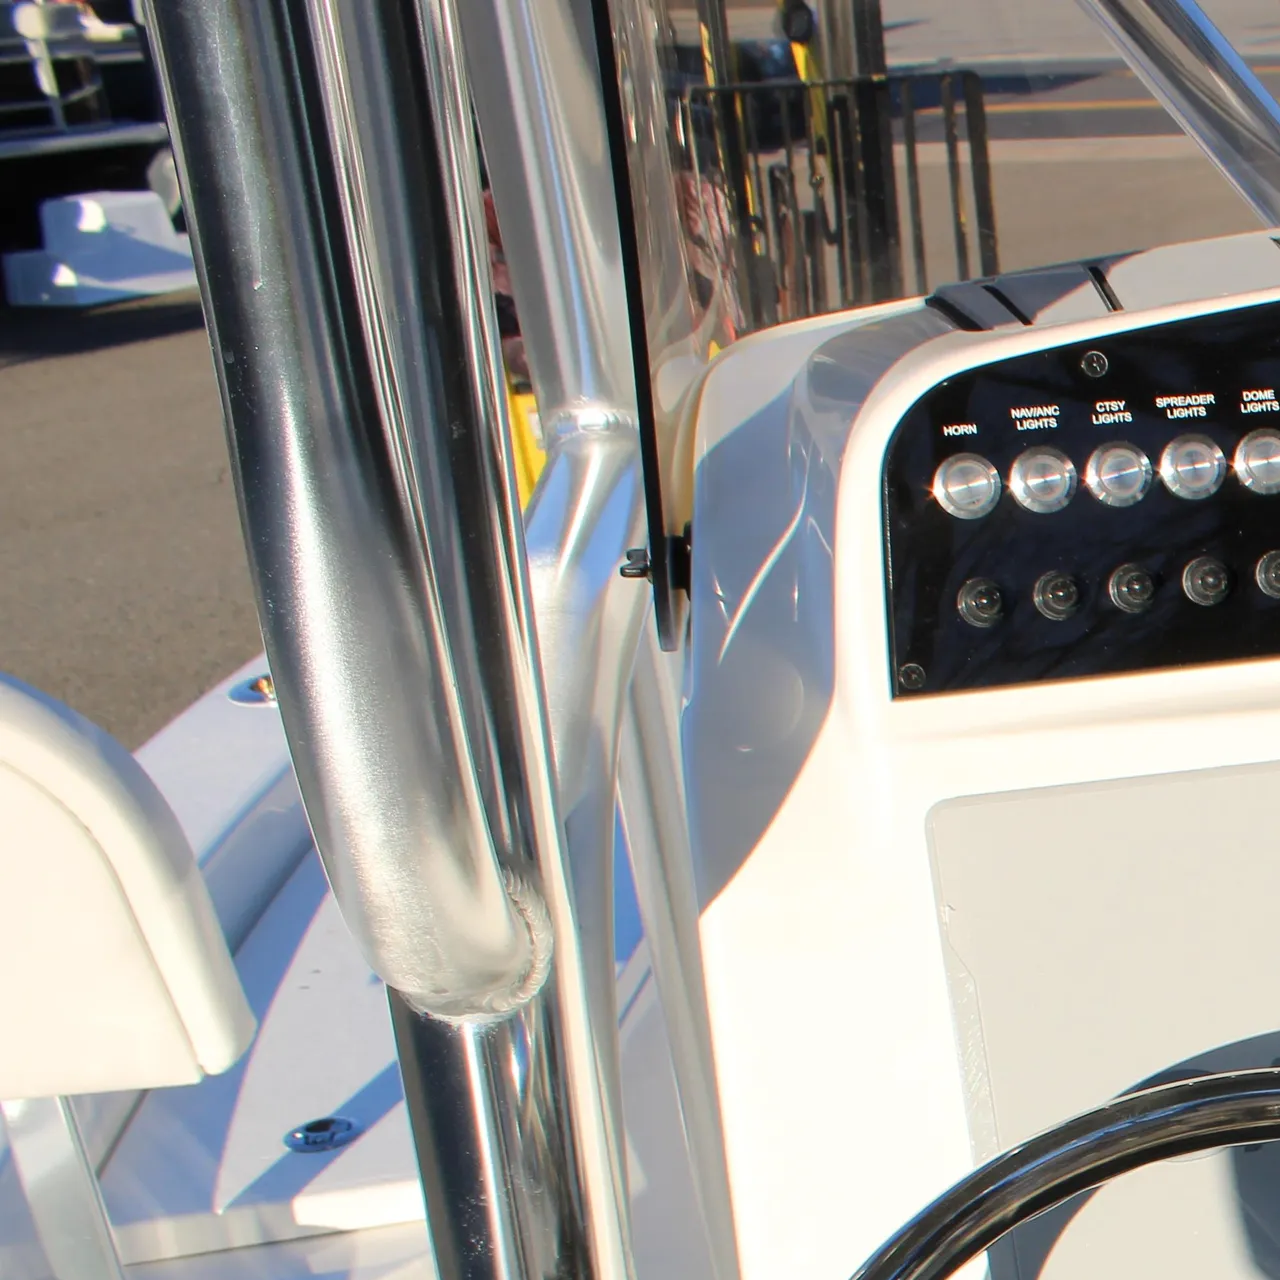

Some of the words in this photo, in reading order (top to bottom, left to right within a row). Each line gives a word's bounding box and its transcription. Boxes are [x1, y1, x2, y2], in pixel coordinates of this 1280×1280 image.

[1155, 394, 1216, 409] SPREADER
[1243, 389, 1276, 402] DOME
[1011, 406, 1060, 420] NAV/ANC
[1095, 401, 1126, 413] CTSY
[1167, 406, 1207, 420] LIGHTS
[1240, 400, 1280, 414] LIGHTS
[1017, 417, 1058, 431] LIGHTS
[1092, 411, 1133, 425] LIGHTS
[944, 424, 977, 437] HORN
